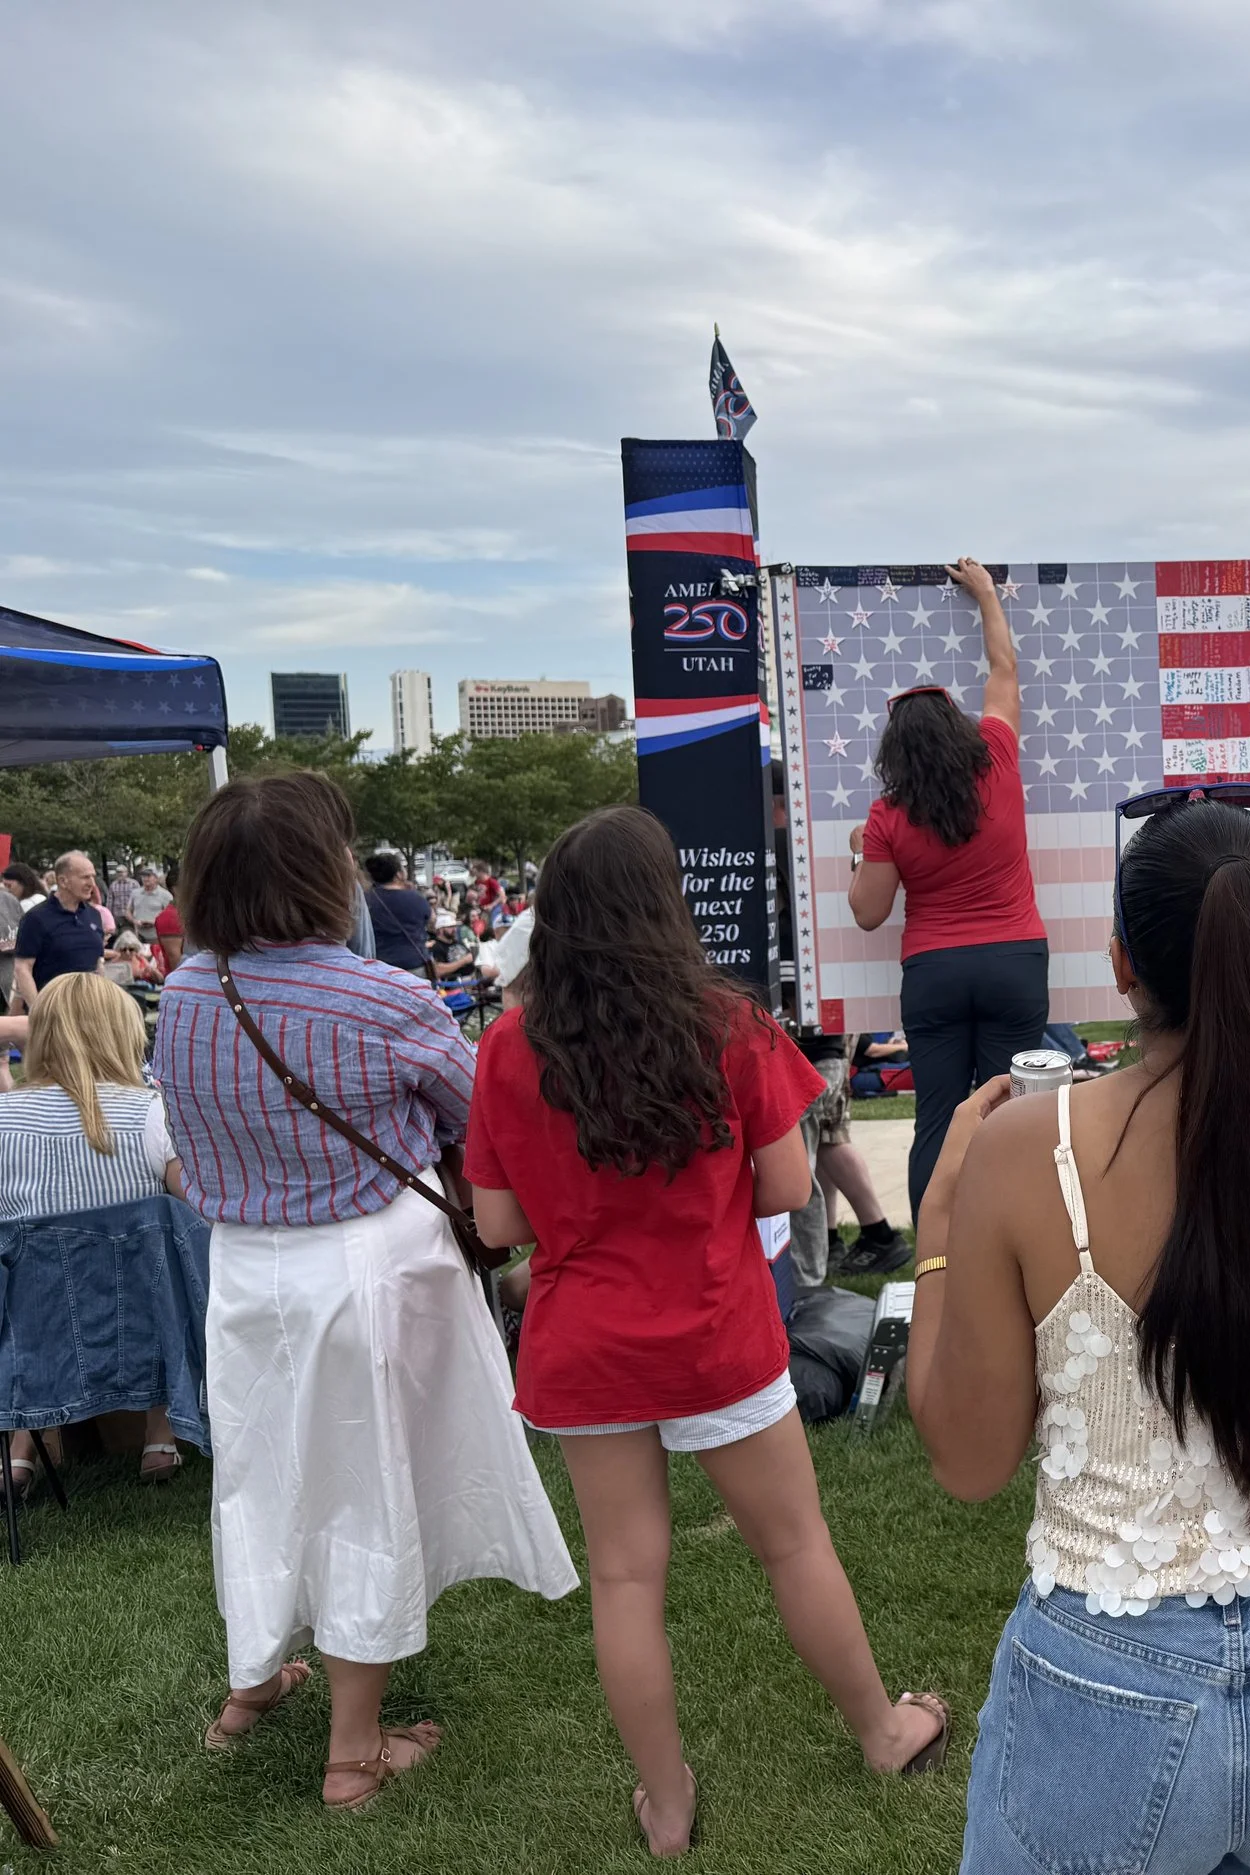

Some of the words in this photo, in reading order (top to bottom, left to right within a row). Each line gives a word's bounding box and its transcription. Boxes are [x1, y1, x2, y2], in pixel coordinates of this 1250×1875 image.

[664, 599, 749, 642] 250
[682, 656, 734, 672] UTAH
[490, 685, 530, 693] KeyBank
[680, 847, 756, 868] Wishes
[682, 872, 715, 897] for
[720, 871, 755, 892] the
[694, 897, 743, 916] next
[700, 923, 740, 943] 250
[705, 948, 751, 965] ears
